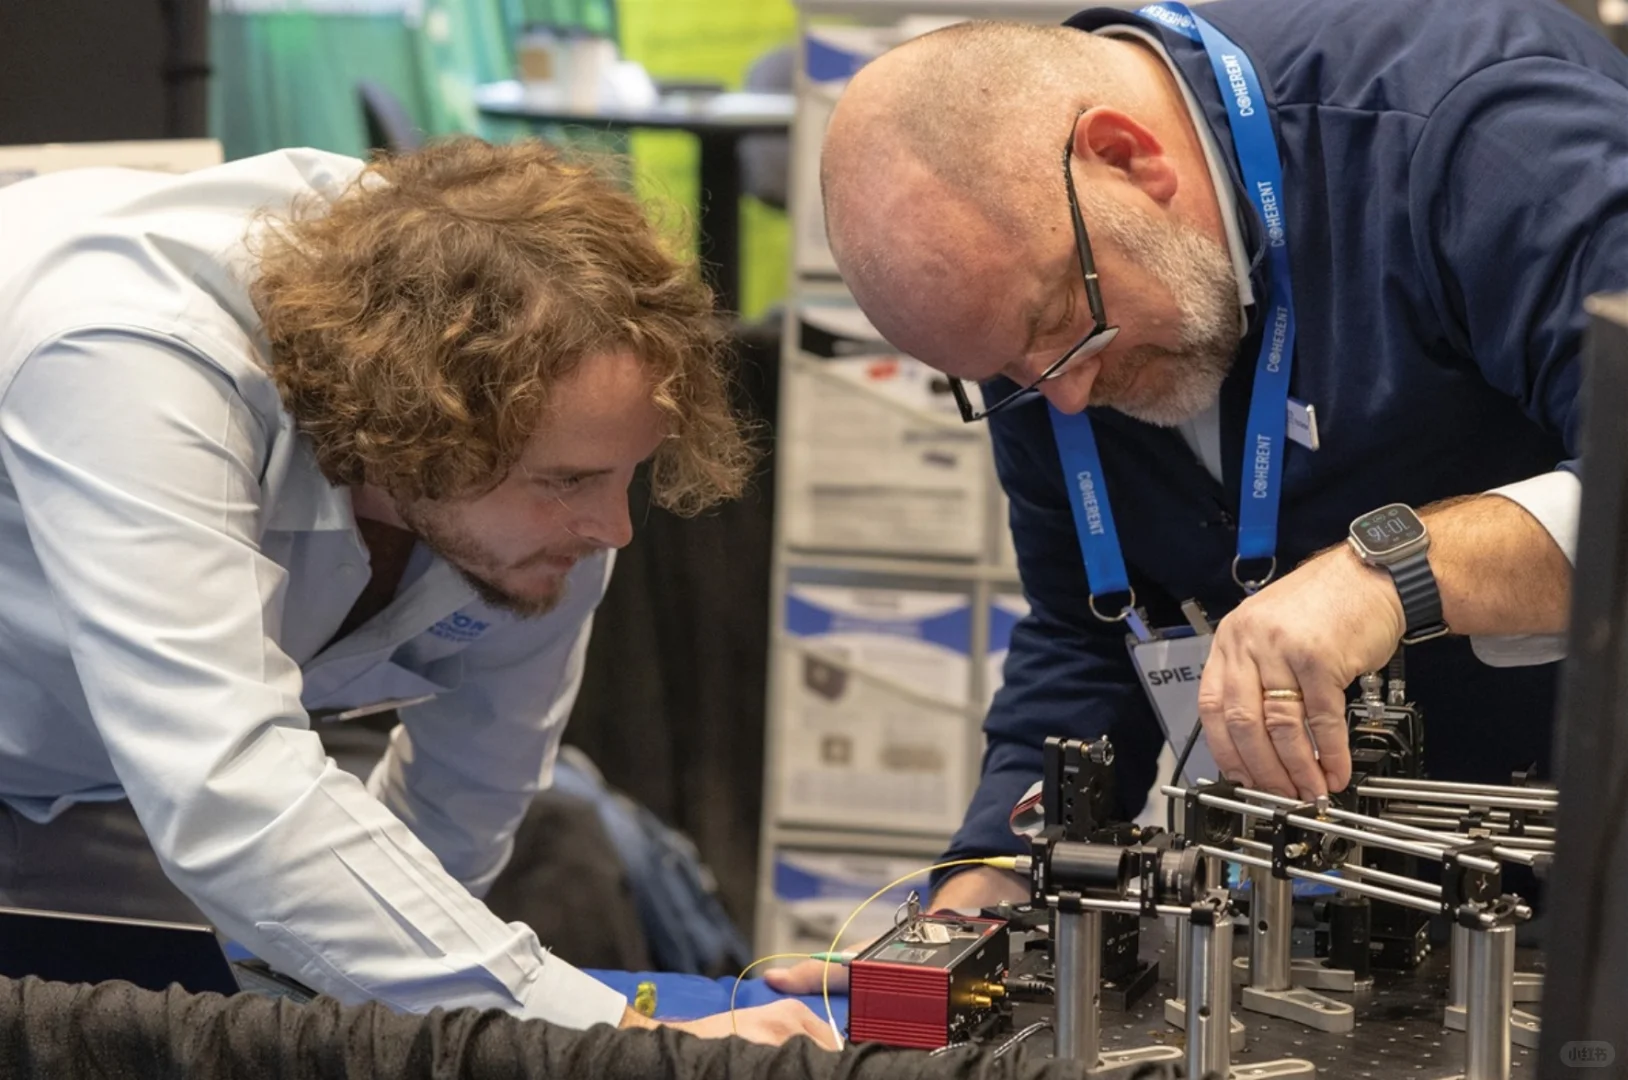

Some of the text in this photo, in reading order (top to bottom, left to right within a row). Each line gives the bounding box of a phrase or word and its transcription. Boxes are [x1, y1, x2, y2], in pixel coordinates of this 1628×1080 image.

[1221, 54, 1254, 117] COHERENT
[1257, 181, 1286, 248] COHERENT
[1267, 306, 1288, 373] COHERENT
[1253, 434, 1272, 499] COHERENT
[1077, 470, 1104, 536] COHERENT
